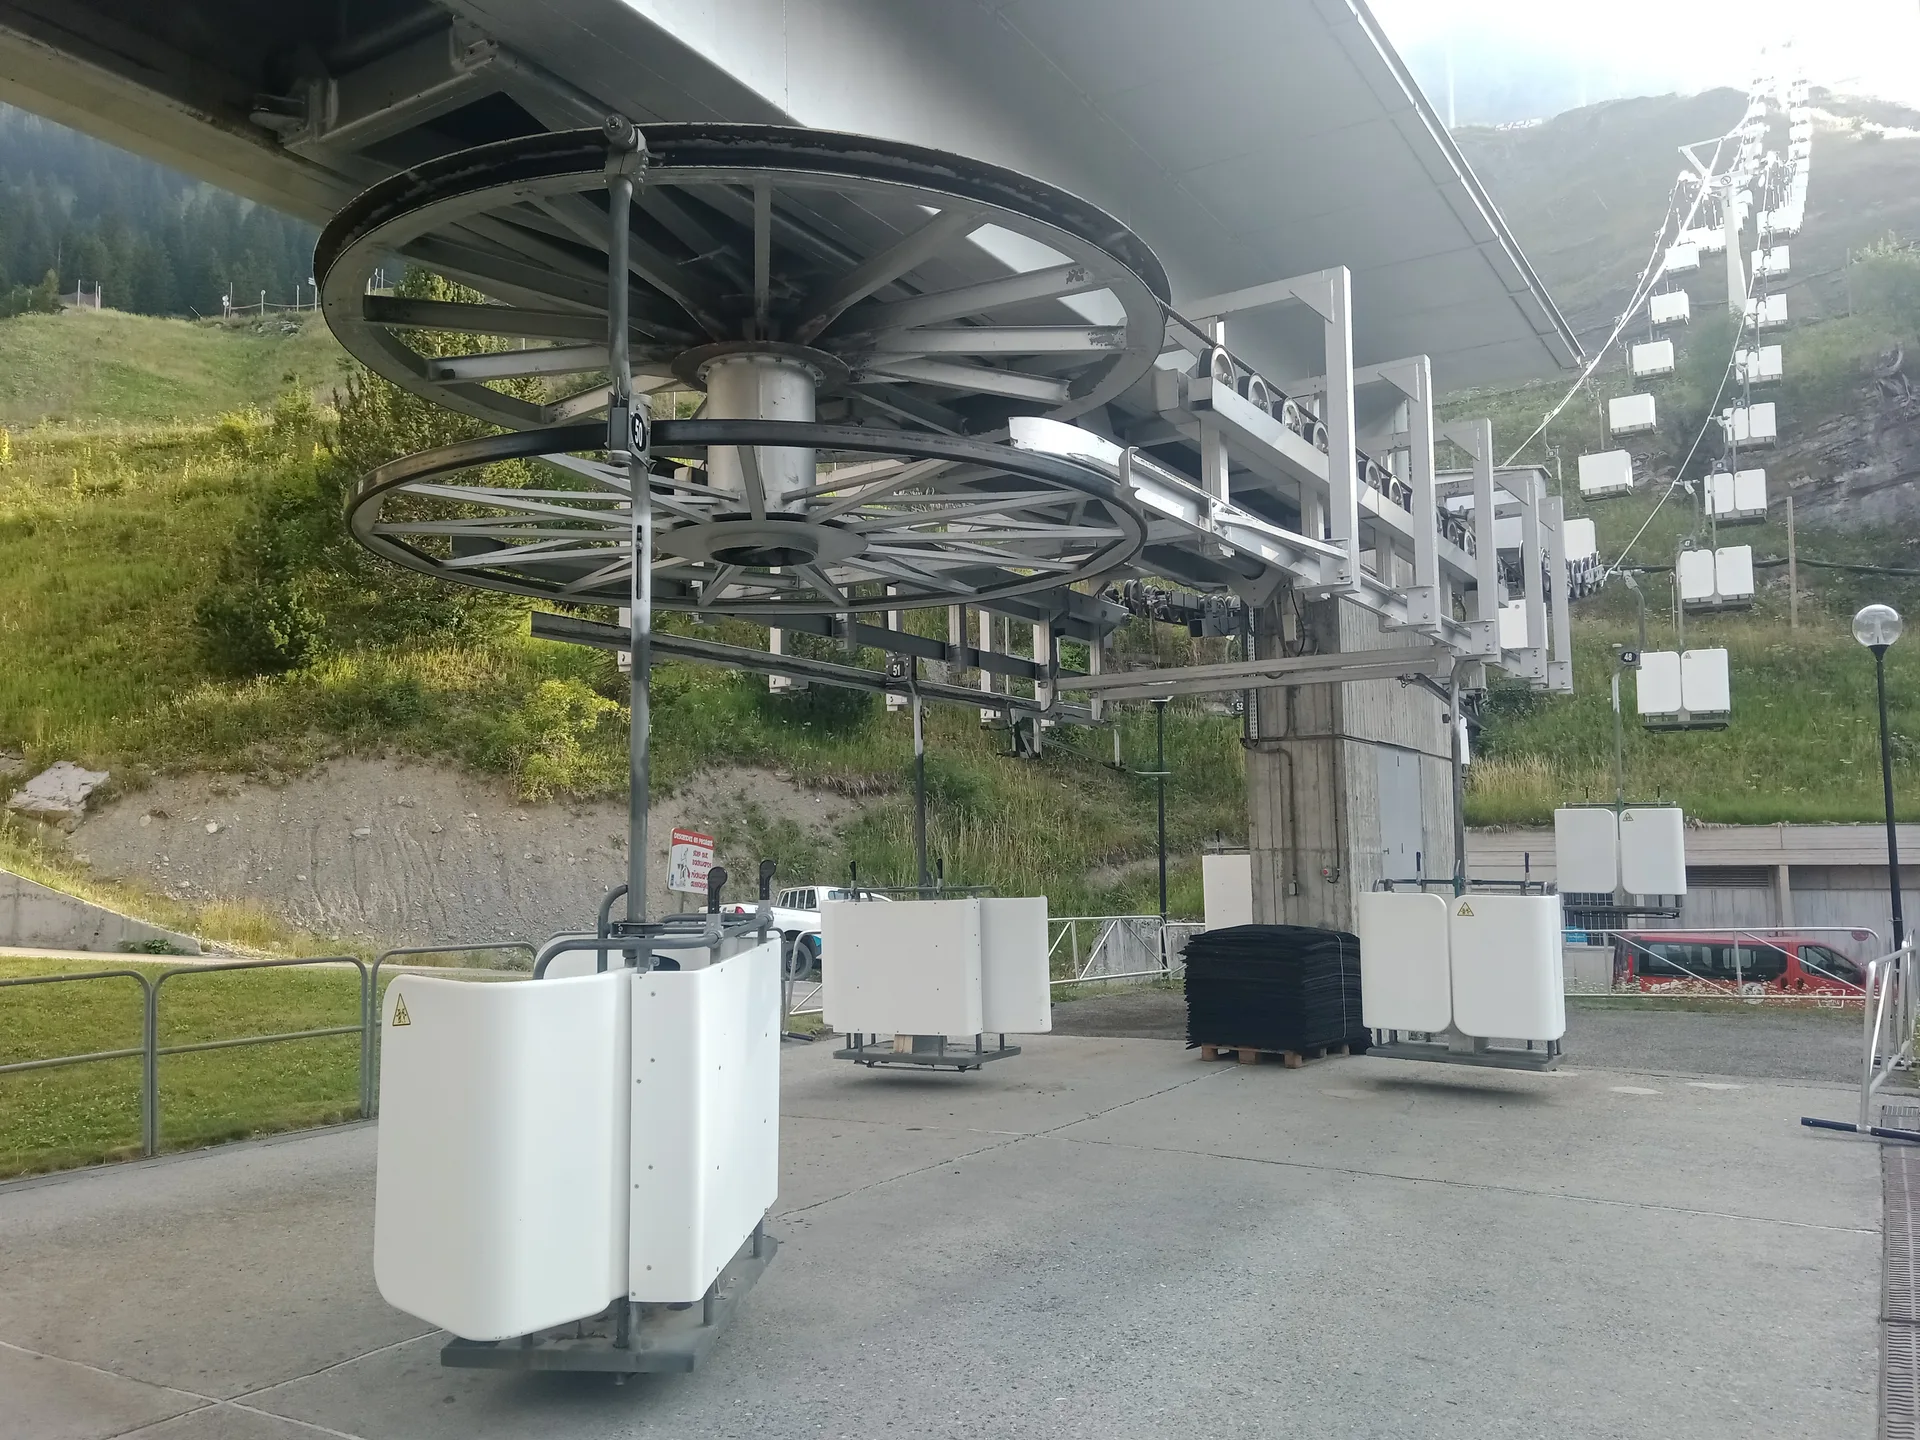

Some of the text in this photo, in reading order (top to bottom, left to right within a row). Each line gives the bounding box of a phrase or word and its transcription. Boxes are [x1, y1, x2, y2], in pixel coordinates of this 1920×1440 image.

[634, 418, 643, 448] 50
[1624, 652, 1633, 661] 48
[892, 664, 901, 676] 51
[1236, 702, 1244, 711] 52
